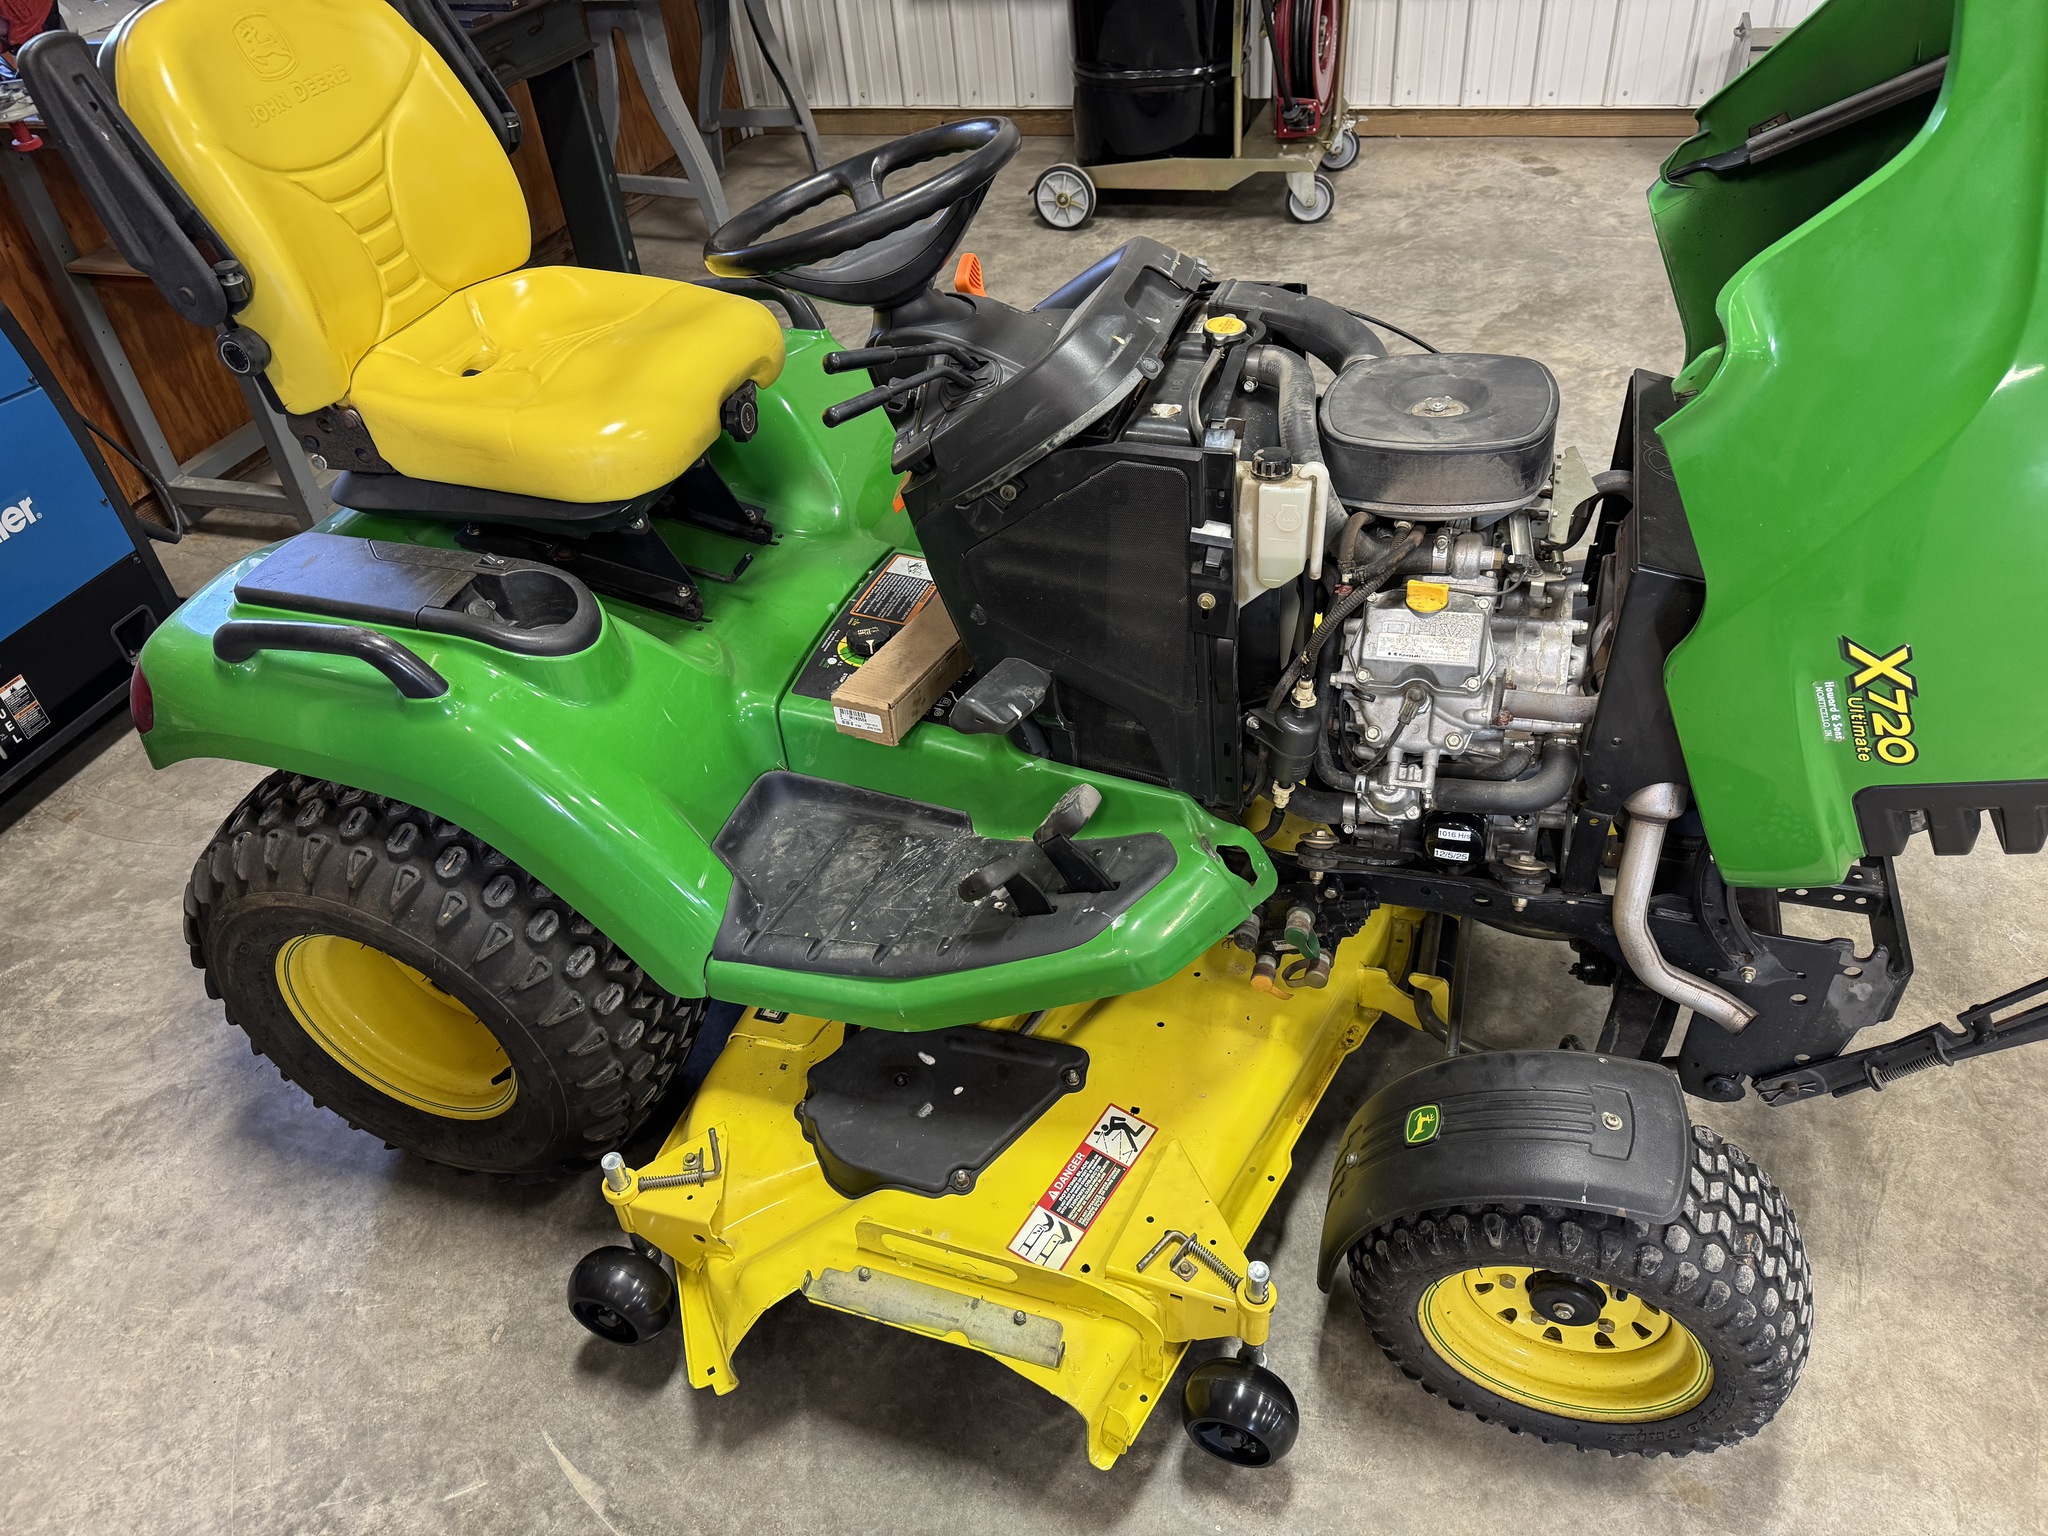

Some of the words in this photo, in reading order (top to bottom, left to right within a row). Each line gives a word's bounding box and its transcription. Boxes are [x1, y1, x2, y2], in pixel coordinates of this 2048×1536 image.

[246, 91, 293, 129] JOHN
[288, 65, 352, 104] DEERE
[1824, 681, 1840, 712] Howard
[1839, 634, 1919, 766] X720
[1847, 696, 1872, 763] Ultimate
[1435, 850, 1468, 860] 12/5/25
[1439, 830, 1457, 838] 1016
[1457, 832, 1471, 840] Hrs
[1053, 1151, 1085, 1190] DANGER
[1058, 1176, 1078, 1201] ROTATING
[1075, 1159, 1089, 1177] BLADE
[1068, 1186, 1086, 1209] THROWN
[1083, 1164, 1101, 1187] OBJECTS
